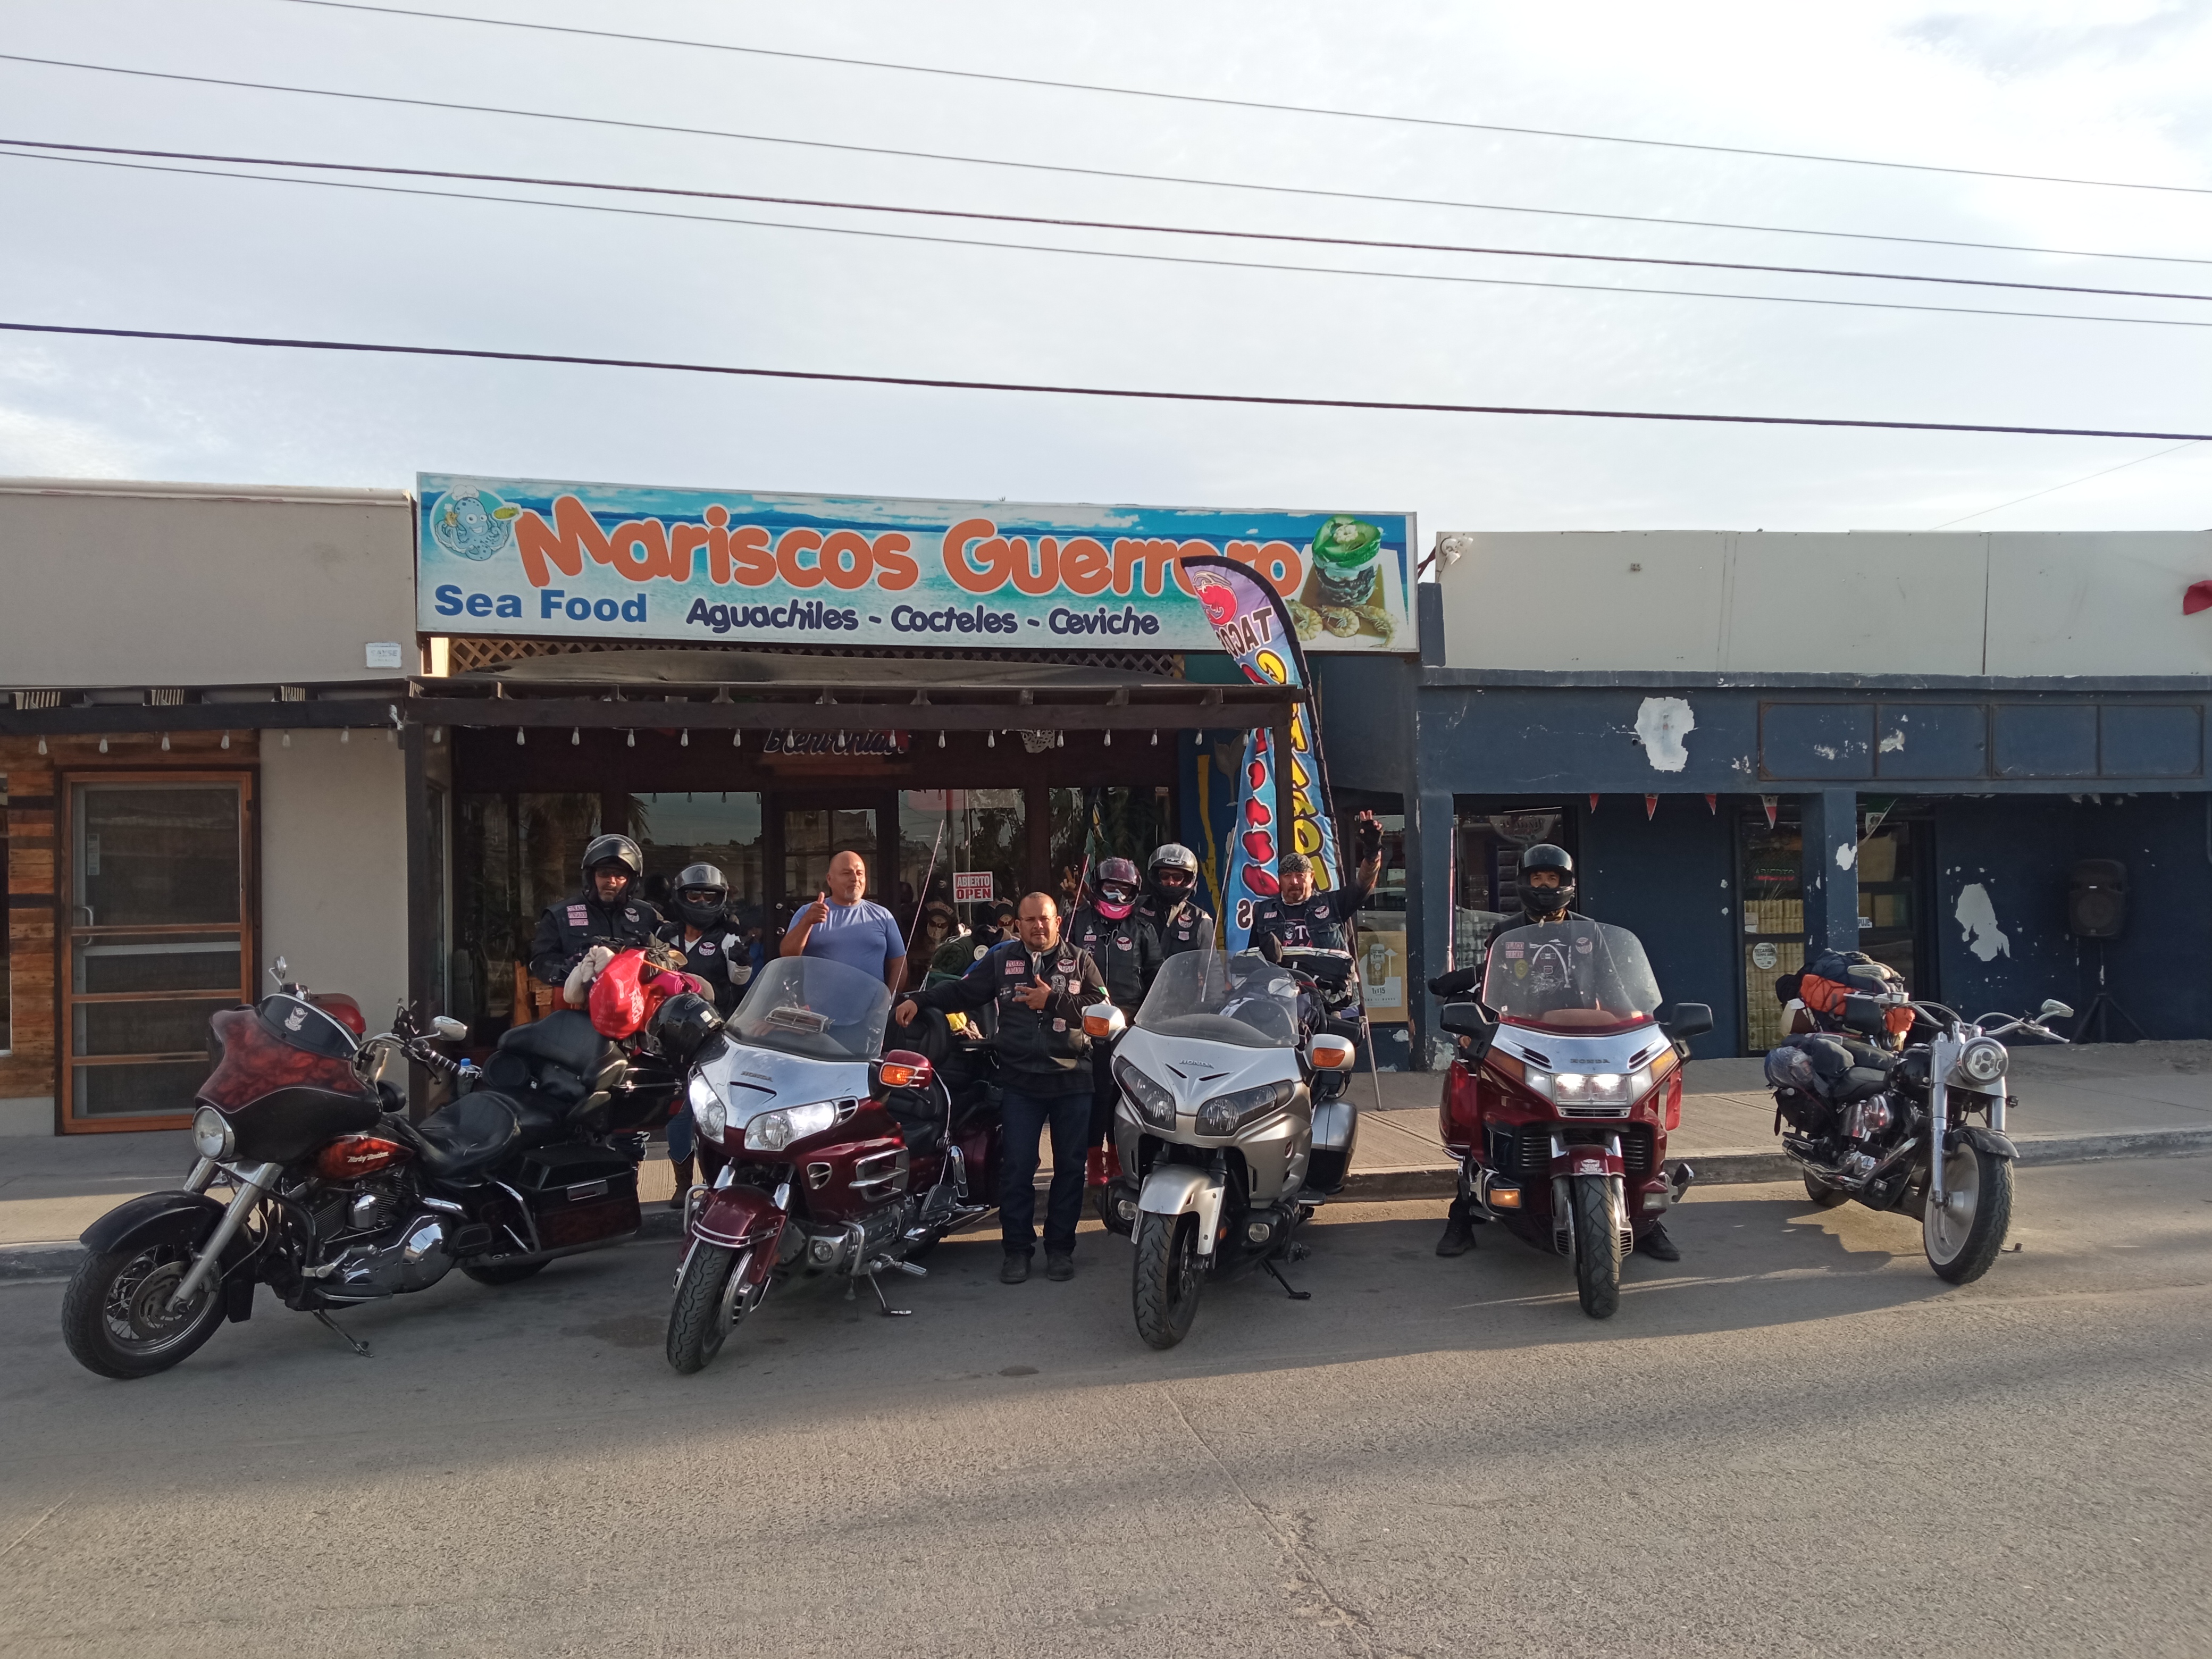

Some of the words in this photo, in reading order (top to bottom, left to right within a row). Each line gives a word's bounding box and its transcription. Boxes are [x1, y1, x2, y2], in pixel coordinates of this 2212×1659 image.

[515, 496, 919, 591] Mariscos
[434, 584, 523, 618] Sea
[541, 589, 647, 623] Food
[686, 598, 859, 633] Aguachiles
[891, 605, 1018, 633] Cocteles
[1049, 606, 1160, 635] Ceviche
[957, 875, 990, 887] ABIERTO
[957, 888, 991, 900] OPEN
[1179, 1060, 1214, 1069] HONDA
